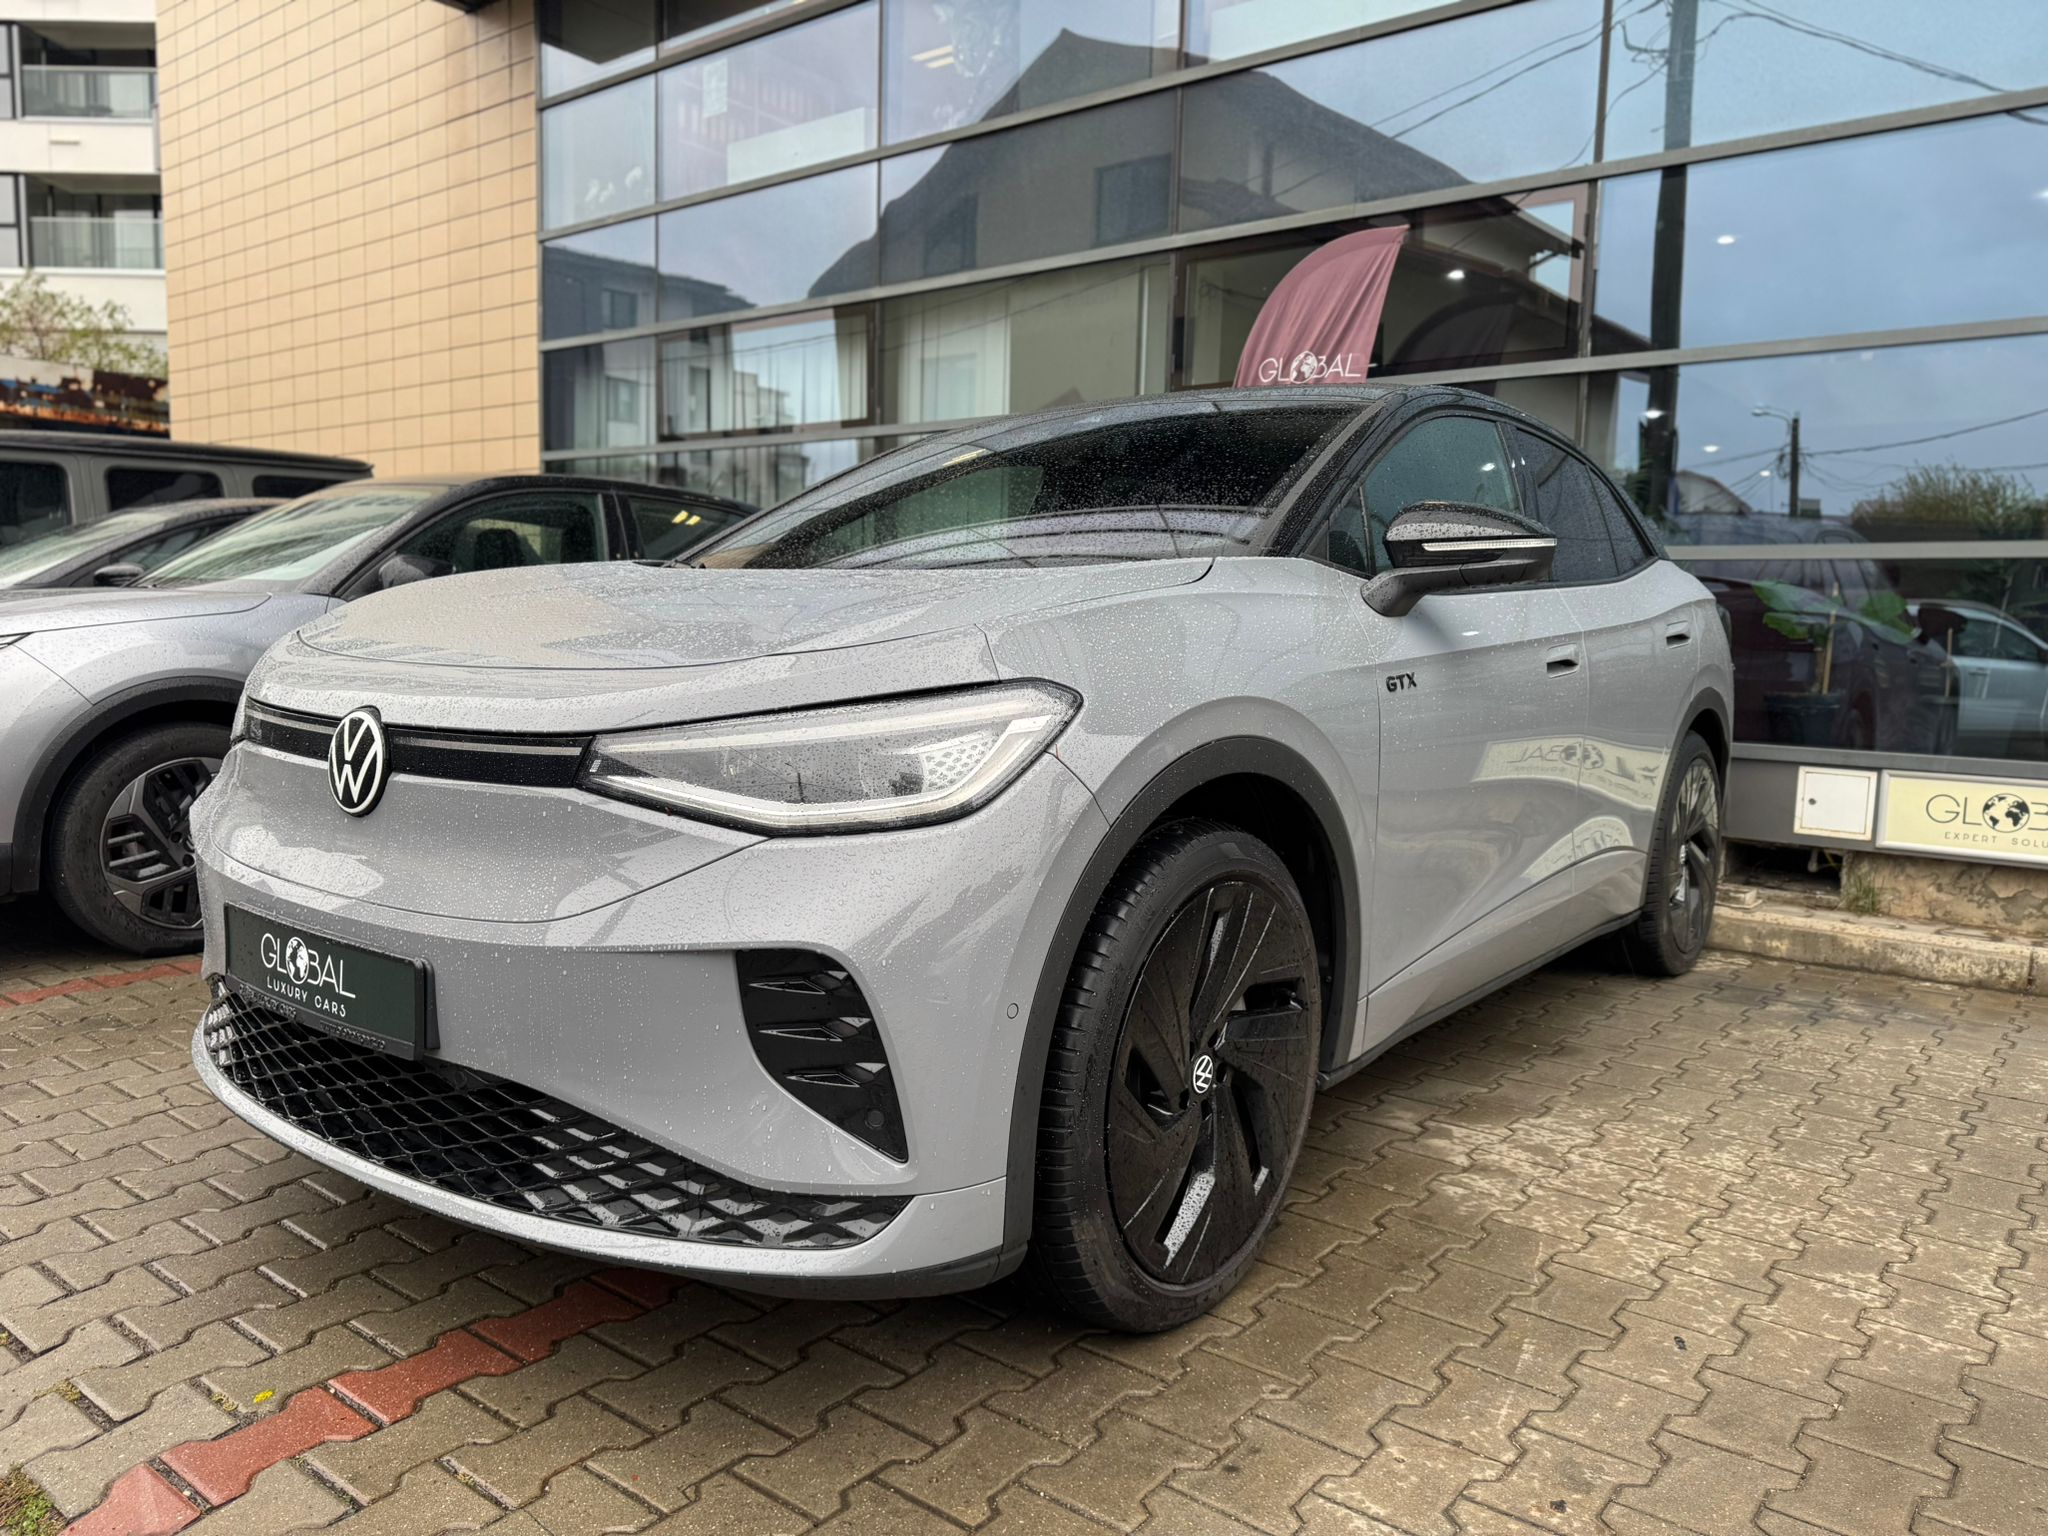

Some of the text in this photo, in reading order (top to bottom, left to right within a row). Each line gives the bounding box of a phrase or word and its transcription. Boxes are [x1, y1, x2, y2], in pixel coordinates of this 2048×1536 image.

[1386, 672, 1417, 692] GTX
[1944, 831, 1998, 844] EXPERT
[260, 932, 357, 999] GLOBAL
[266, 975, 308, 1003] LUXURY
[314, 995, 347, 1018] CARS
